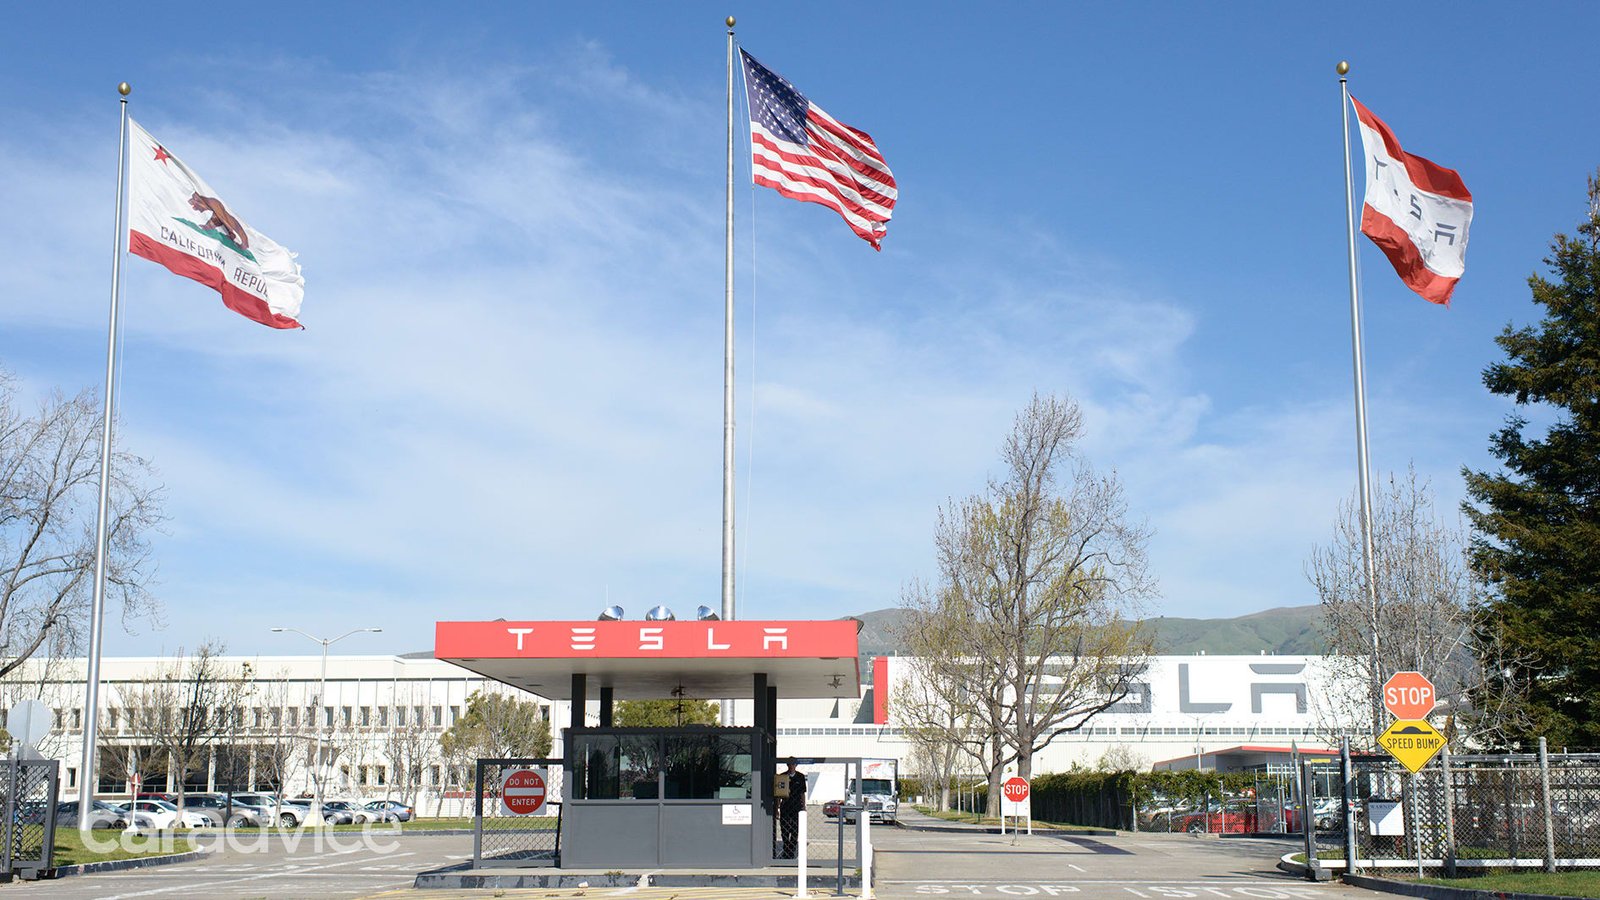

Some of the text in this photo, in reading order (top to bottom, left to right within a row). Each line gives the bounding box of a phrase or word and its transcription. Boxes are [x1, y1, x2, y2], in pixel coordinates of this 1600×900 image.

[507, 628, 788, 650] TESLA
[1387, 687, 1431, 706] STOP
[1386, 738, 1441, 749] SPEED BUMP
[509, 778, 540, 786] DO NOT
[1005, 784, 1028, 795] STOP
[511, 798, 536, 806] ENTER
[915, 884, 1081, 896] STOP
[1148, 886, 1324, 900] STOP
